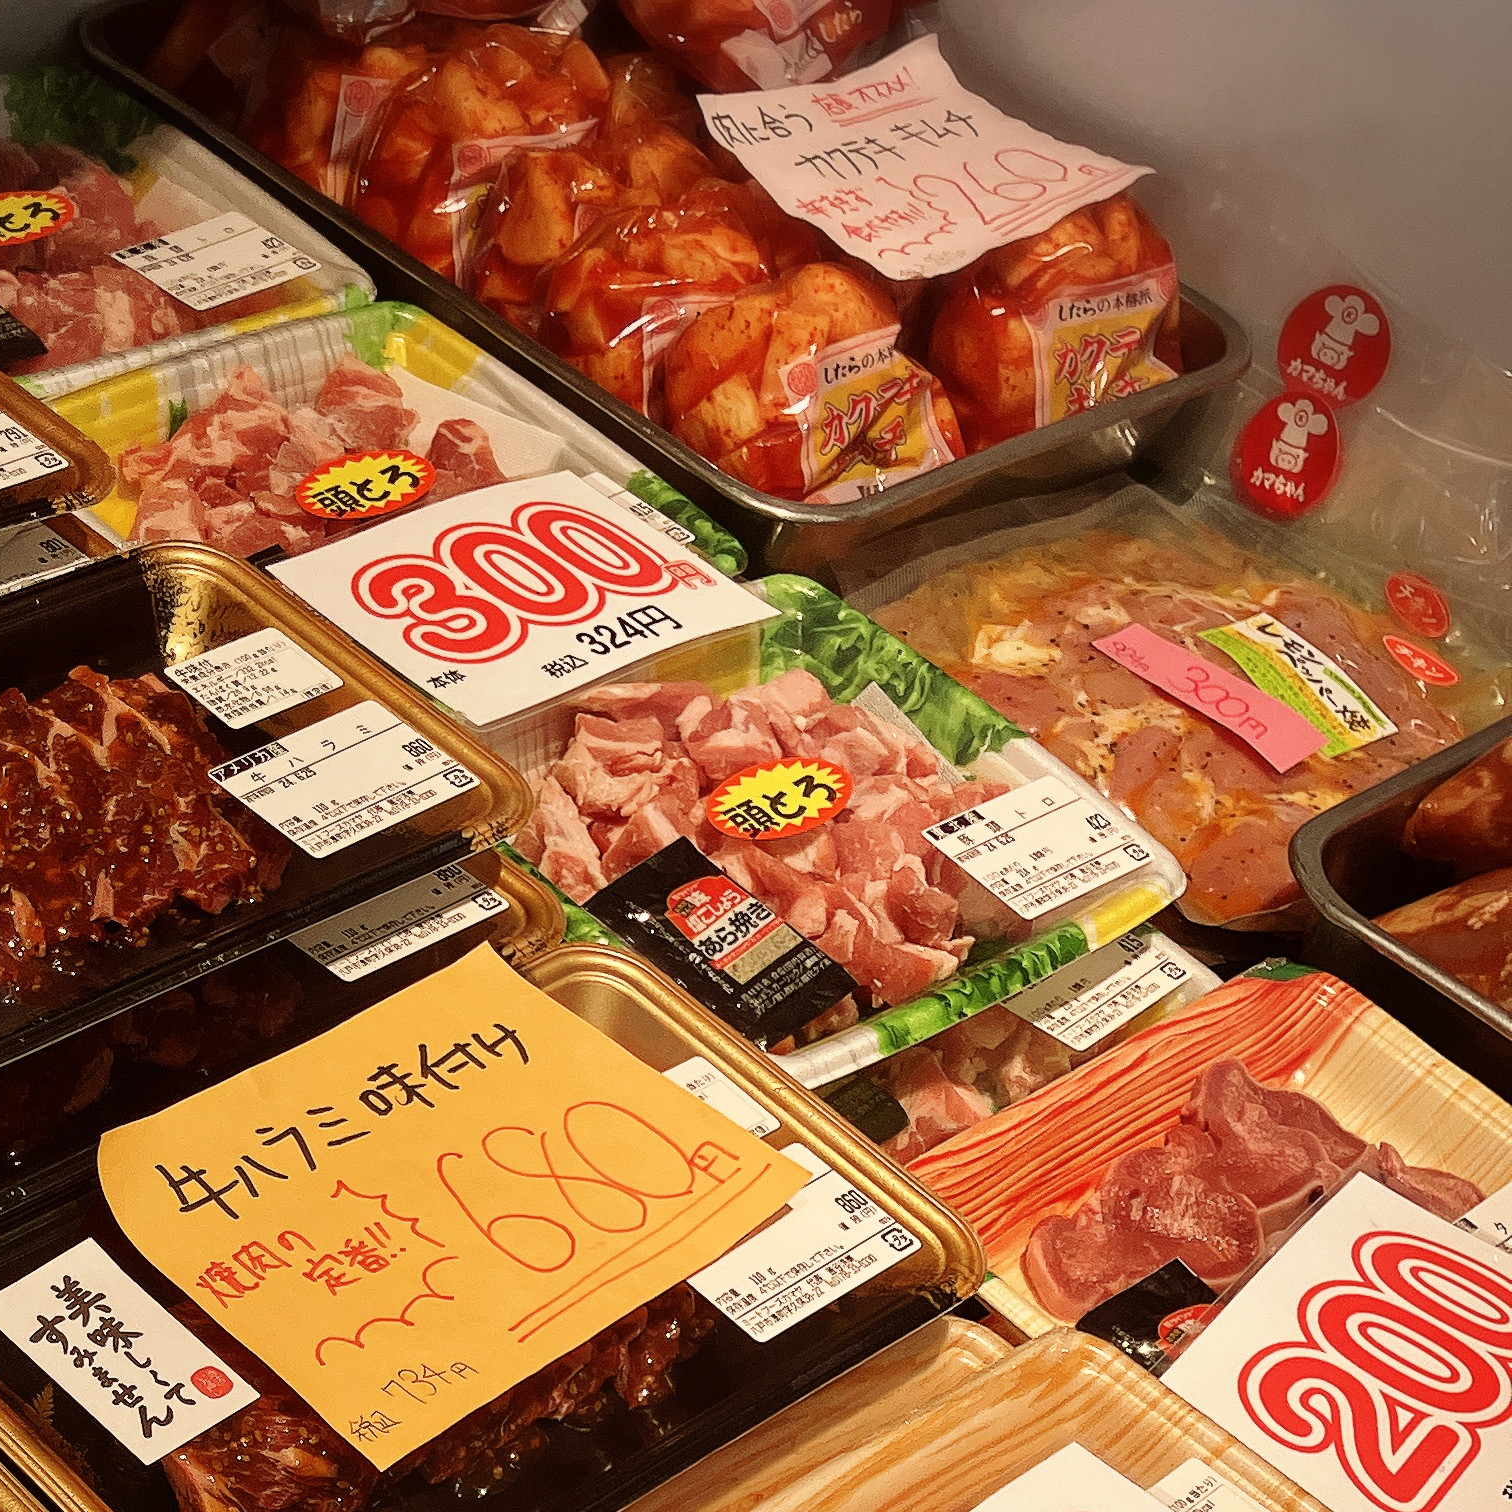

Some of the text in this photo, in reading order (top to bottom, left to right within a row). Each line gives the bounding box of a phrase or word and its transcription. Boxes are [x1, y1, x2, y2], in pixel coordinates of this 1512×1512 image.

[712, 104, 812, 148] 肉に合う
[795, 110, 978, 179] カクテキ キムチ
[1287, 358, 1346, 401] カマちゃん
[316, 462, 421, 516] 頭とろ
[1250, 468, 1305, 502] カマちゃん
[352, 501, 719, 665] 300円
[541, 604, 684, 679] 税込 324円
[426, 668, 467, 690] 本体
[252, 724, 373, 782] 牛ハラミ
[402, 738, 434, 757] 860
[727, 775, 838, 838] 頭とろ
[697, 902, 772, 956] あら挽き
[156, 1022, 532, 1223] 牛ハラミ味付け
[437, 1102, 741, 1274] 680円
[835, 1190, 867, 1213] 860
[195, 1231, 317, 1310] 焼肉の
